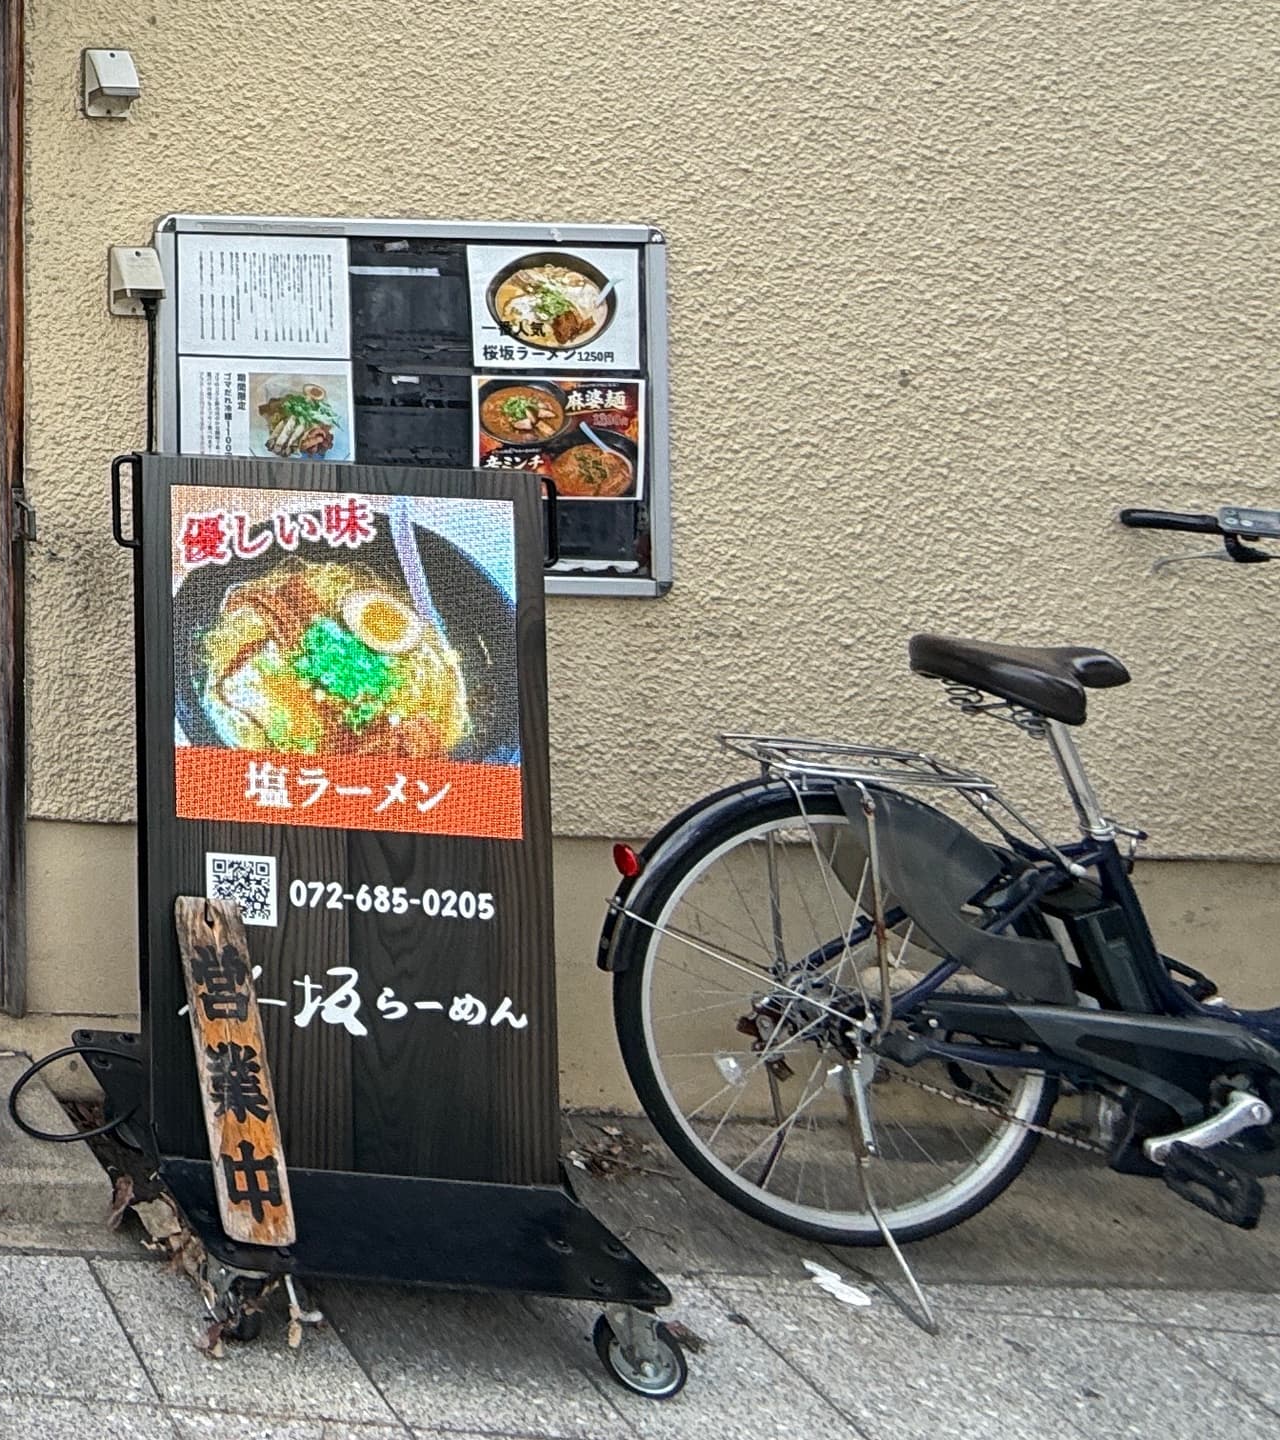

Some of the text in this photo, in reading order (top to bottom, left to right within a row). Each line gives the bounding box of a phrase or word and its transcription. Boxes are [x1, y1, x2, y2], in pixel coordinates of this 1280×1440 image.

[481, 320, 547, 338] 一番人気
[482, 344, 615, 363] 桜坂ラーメン 1250円
[180, 497, 375, 563] 優しい味
[244, 760, 452, 813] 塩ラーメン
[288, 879, 495, 920] 072-685-0205
[192, 944, 283, 1224] 営業中
